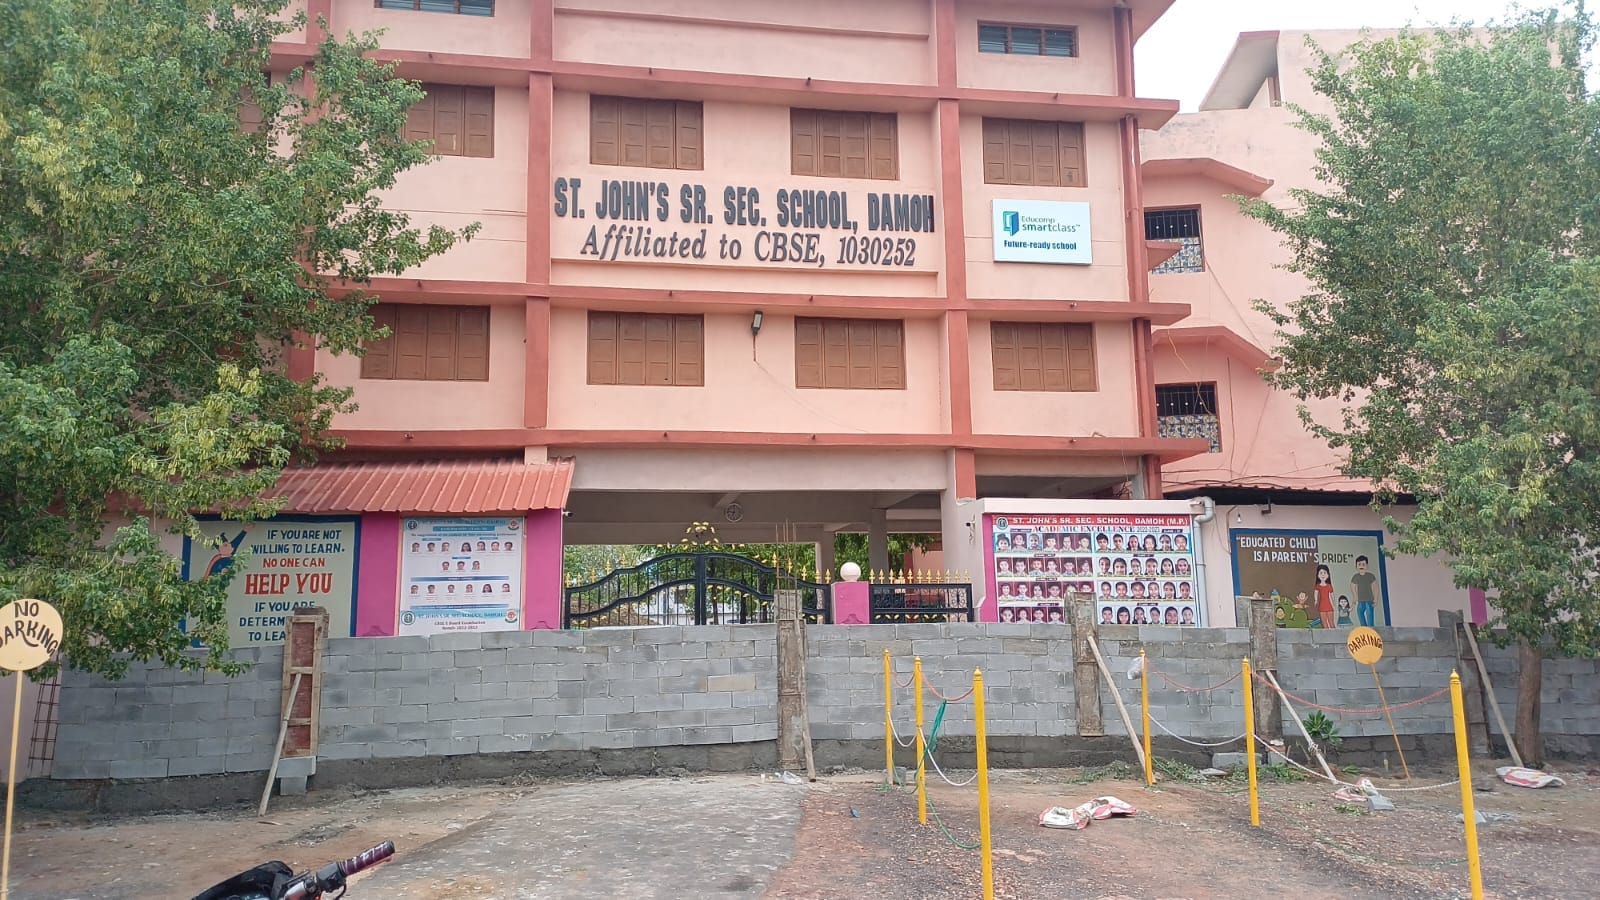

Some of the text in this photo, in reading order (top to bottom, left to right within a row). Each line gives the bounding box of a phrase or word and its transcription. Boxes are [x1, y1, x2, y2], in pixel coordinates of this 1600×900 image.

[554, 177, 935, 234] ST. JOHN'S SR. SEC. SCHOOL, DAMOH
[1021, 216, 1055, 224] Educomp
[580, 223, 916, 267] Affiliated to CBSE, 1030252
[1004, 240, 1077, 250] Future-ready school
[1097, 517, 1133, 525] SCHOOL,
[1135, 517, 1164, 525] DAMOH
[267, 530, 342, 540] IF YOU ARE NOT
[1289, 537, 1317, 549] CHILD
[251, 543, 345, 554] WILLING TO LEARN.
[1254, 551, 1261, 562] IS
[1263, 551, 1270, 562] A
[1271, 552, 1319, 563] PARENT'S
[263, 558, 325, 568] NO ONE CAN
[244, 573, 333, 594] HELP YOU
[14, 601, 39, 618] NO
[255, 602, 266, 612] IF
[269, 602, 290, 612] YOU
[240, 617, 285, 627] DETERM
[248, 631, 286, 641] TO LEA
[1349, 634, 1383, 653] PARKING
